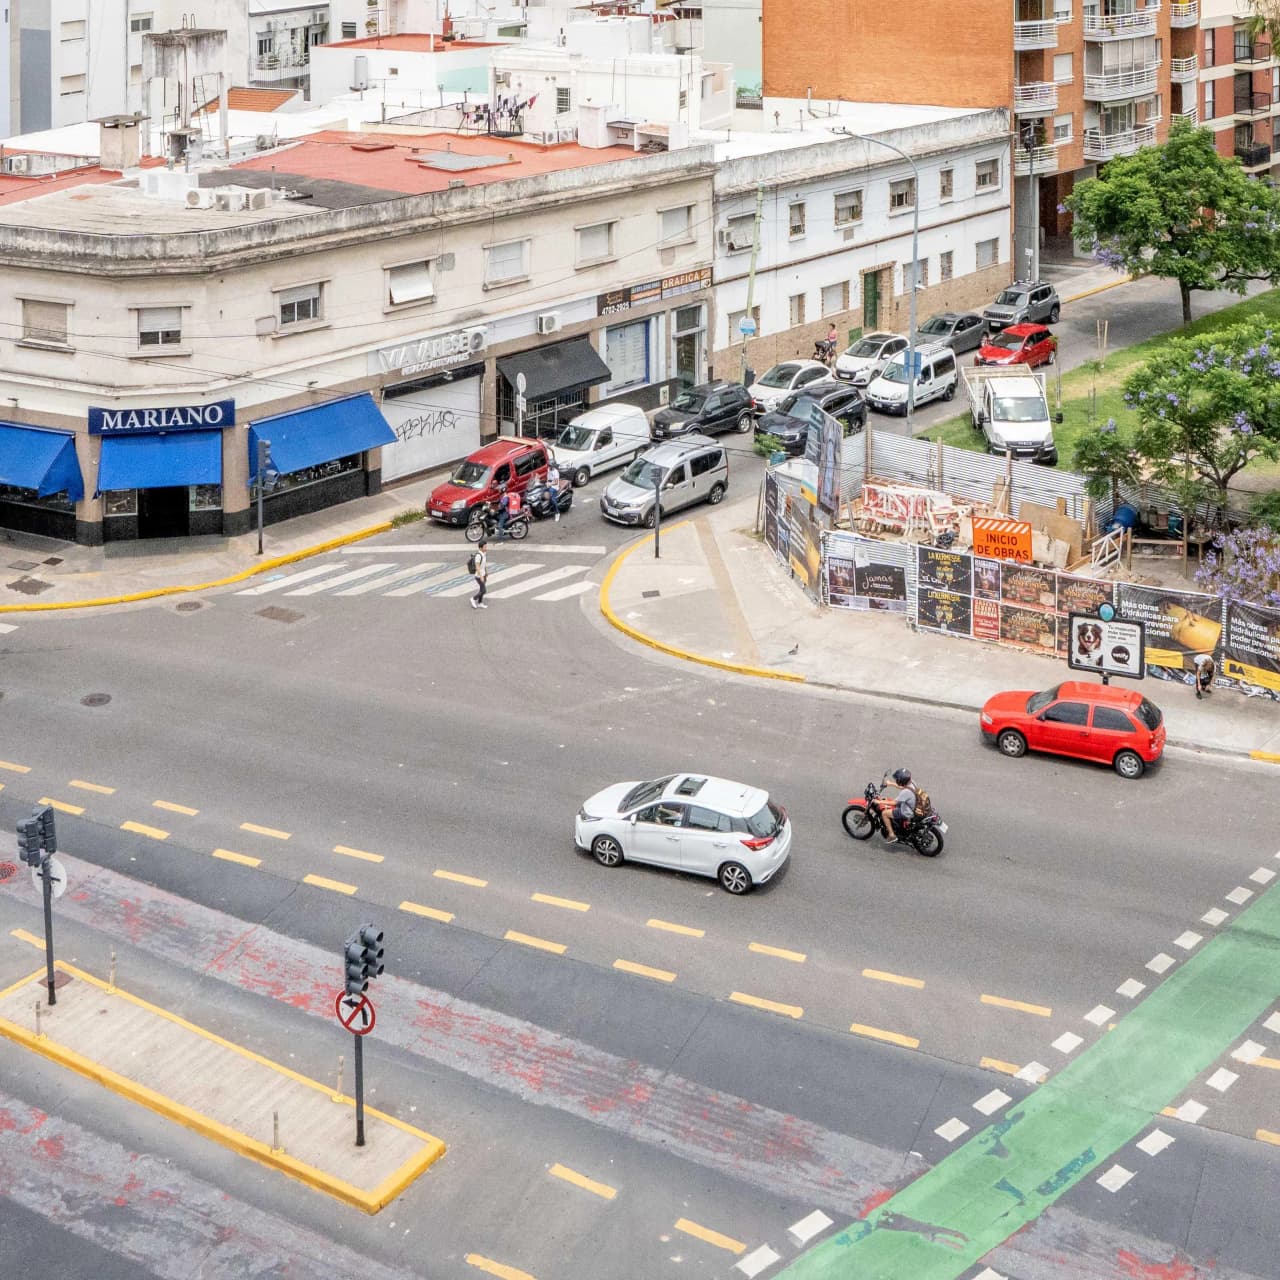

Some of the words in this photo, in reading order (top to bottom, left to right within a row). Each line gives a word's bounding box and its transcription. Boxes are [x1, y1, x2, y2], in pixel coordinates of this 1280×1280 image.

[662, 272, 699, 289] GRAFICA
[101, 405, 223, 430] MARIANO
[986, 533, 1017, 545] INICIO
[977, 544, 990, 554] DE
[994, 546, 1029, 560] OBRAS
[1121, 600, 1137, 609] Más
[1138, 602, 1159, 611] obras
[1162, 615, 1179, 624] para
[1231, 617, 1246, 627] Más
[1247, 621, 1268, 632] obras
[1230, 625, 1269, 641] hidráulicas
[1230, 634, 1251, 644] poder
[1230, 641, 1278, 660] inundaciones
